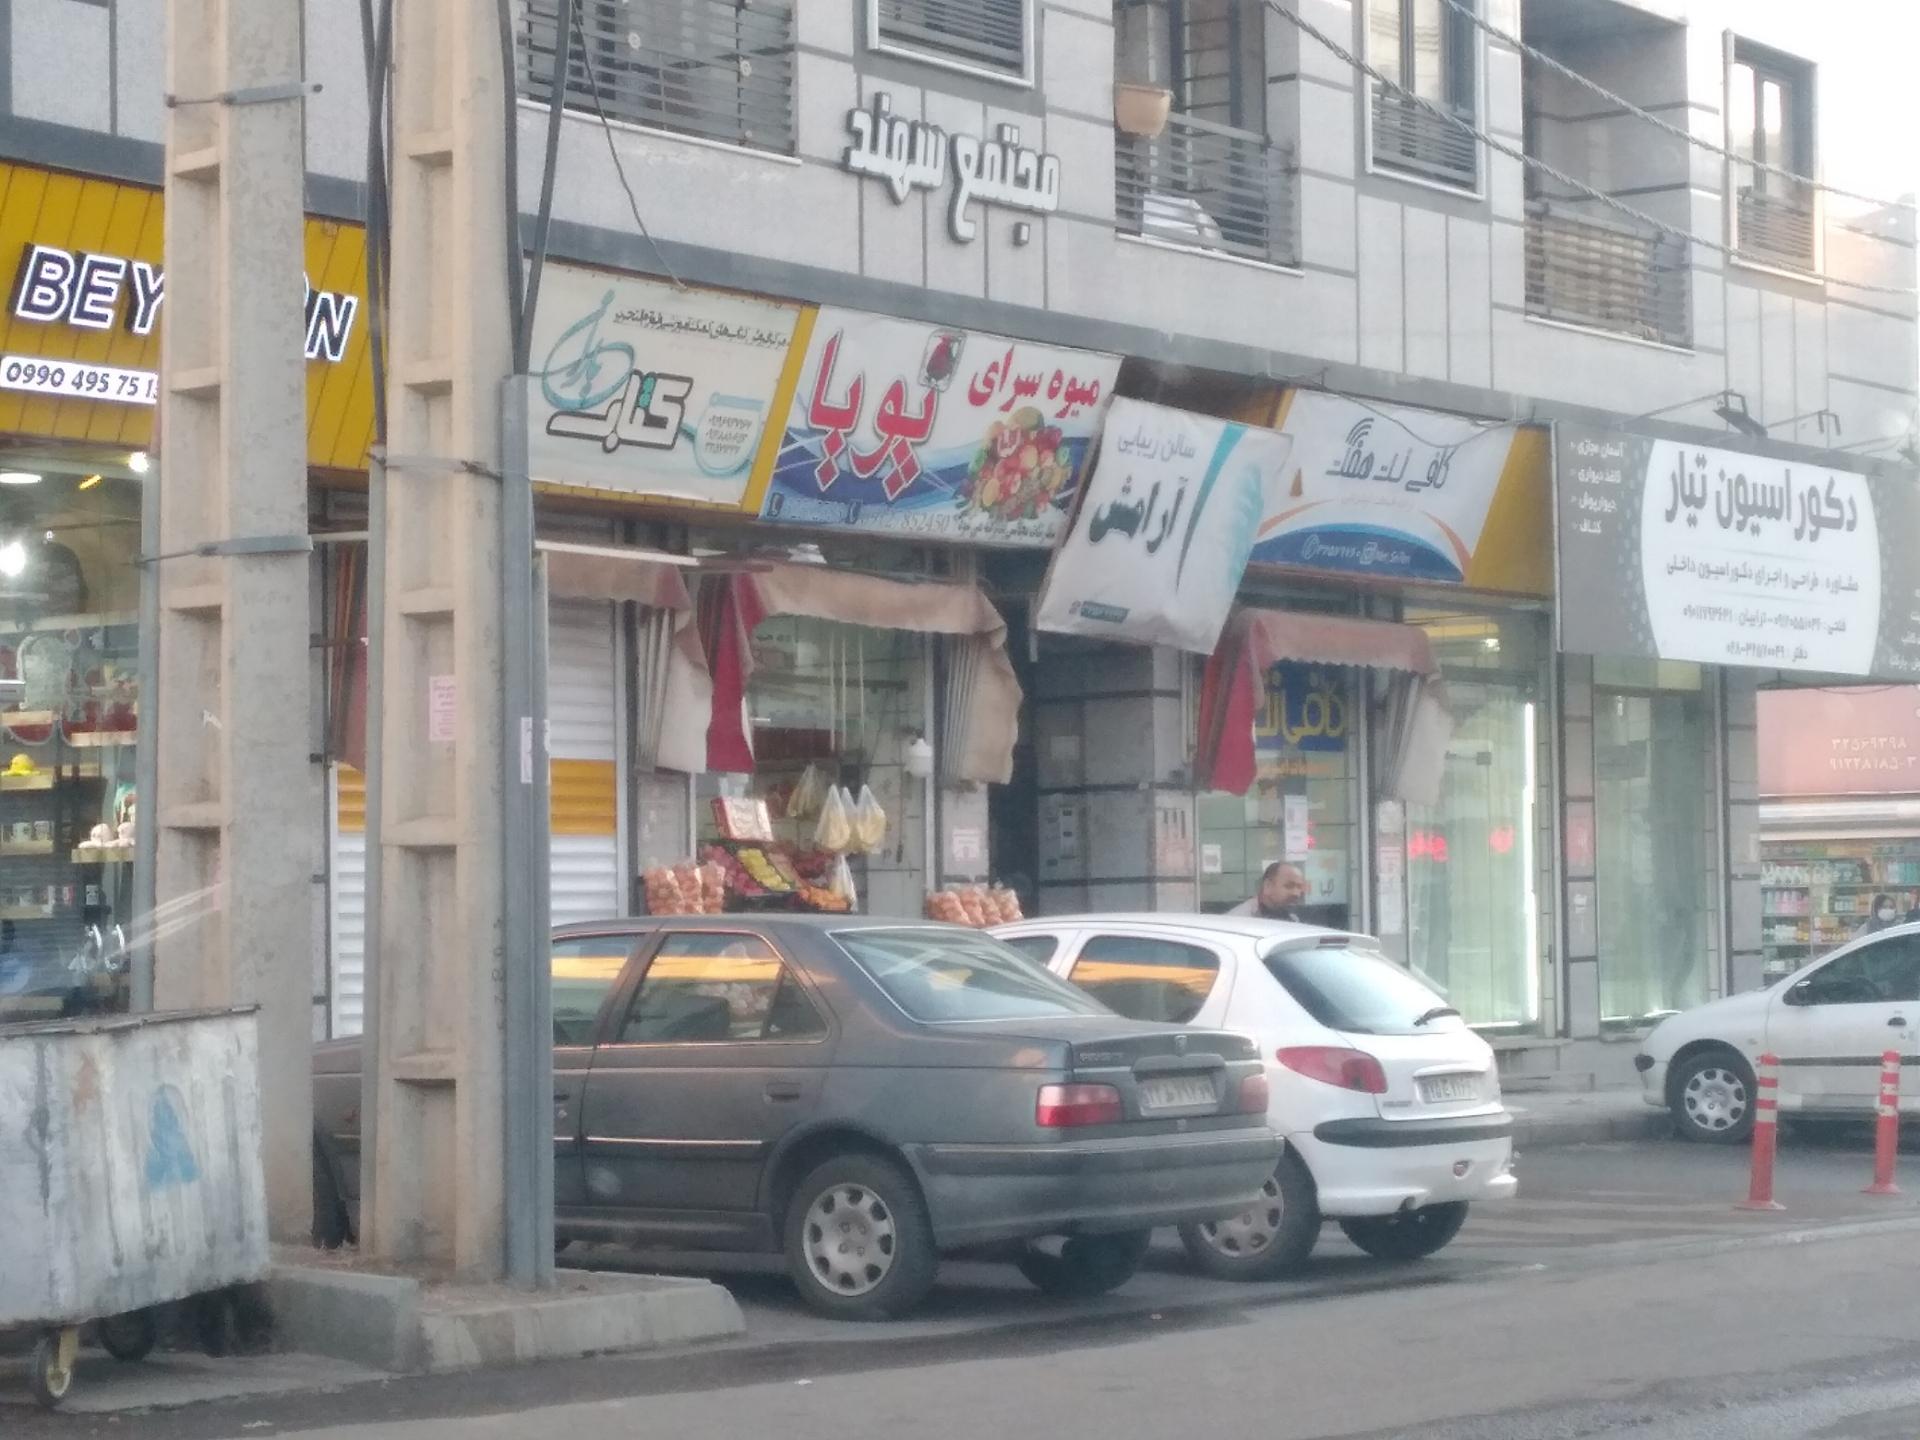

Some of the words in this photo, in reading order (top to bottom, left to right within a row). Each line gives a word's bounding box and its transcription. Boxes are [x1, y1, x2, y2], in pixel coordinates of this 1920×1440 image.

[845, 91, 948, 203] سهند
[951, 122, 1061, 245] مجتمع
[6, 362, 65, 387] 0990
[71, 369, 110, 392] 495
[116, 374, 139, 396] 75
[967, 344, 1043, 412] سرای
[1046, 367, 1100, 418] میوه
